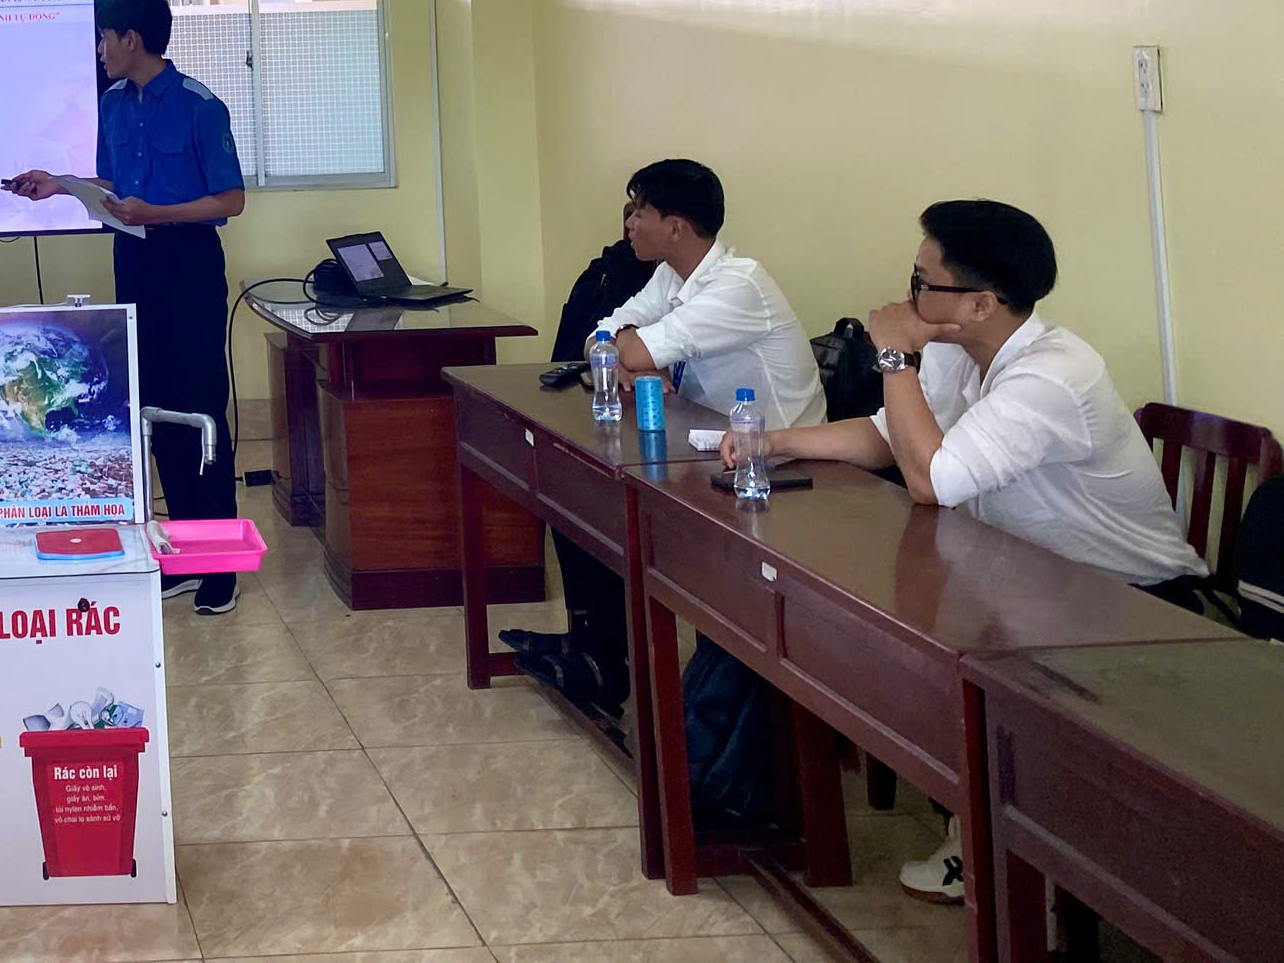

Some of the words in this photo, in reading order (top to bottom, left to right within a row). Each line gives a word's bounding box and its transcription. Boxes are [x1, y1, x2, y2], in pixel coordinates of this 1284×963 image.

[28, 505, 52, 520] LOẠI
[55, 503, 68, 517] LÀ
[71, 501, 101, 516] THẢM
[66, 601, 121, 637] RÁC
[54, 766, 75, 780] Rác
[79, 766, 99, 778] còn
[103, 765, 117, 780] lại
